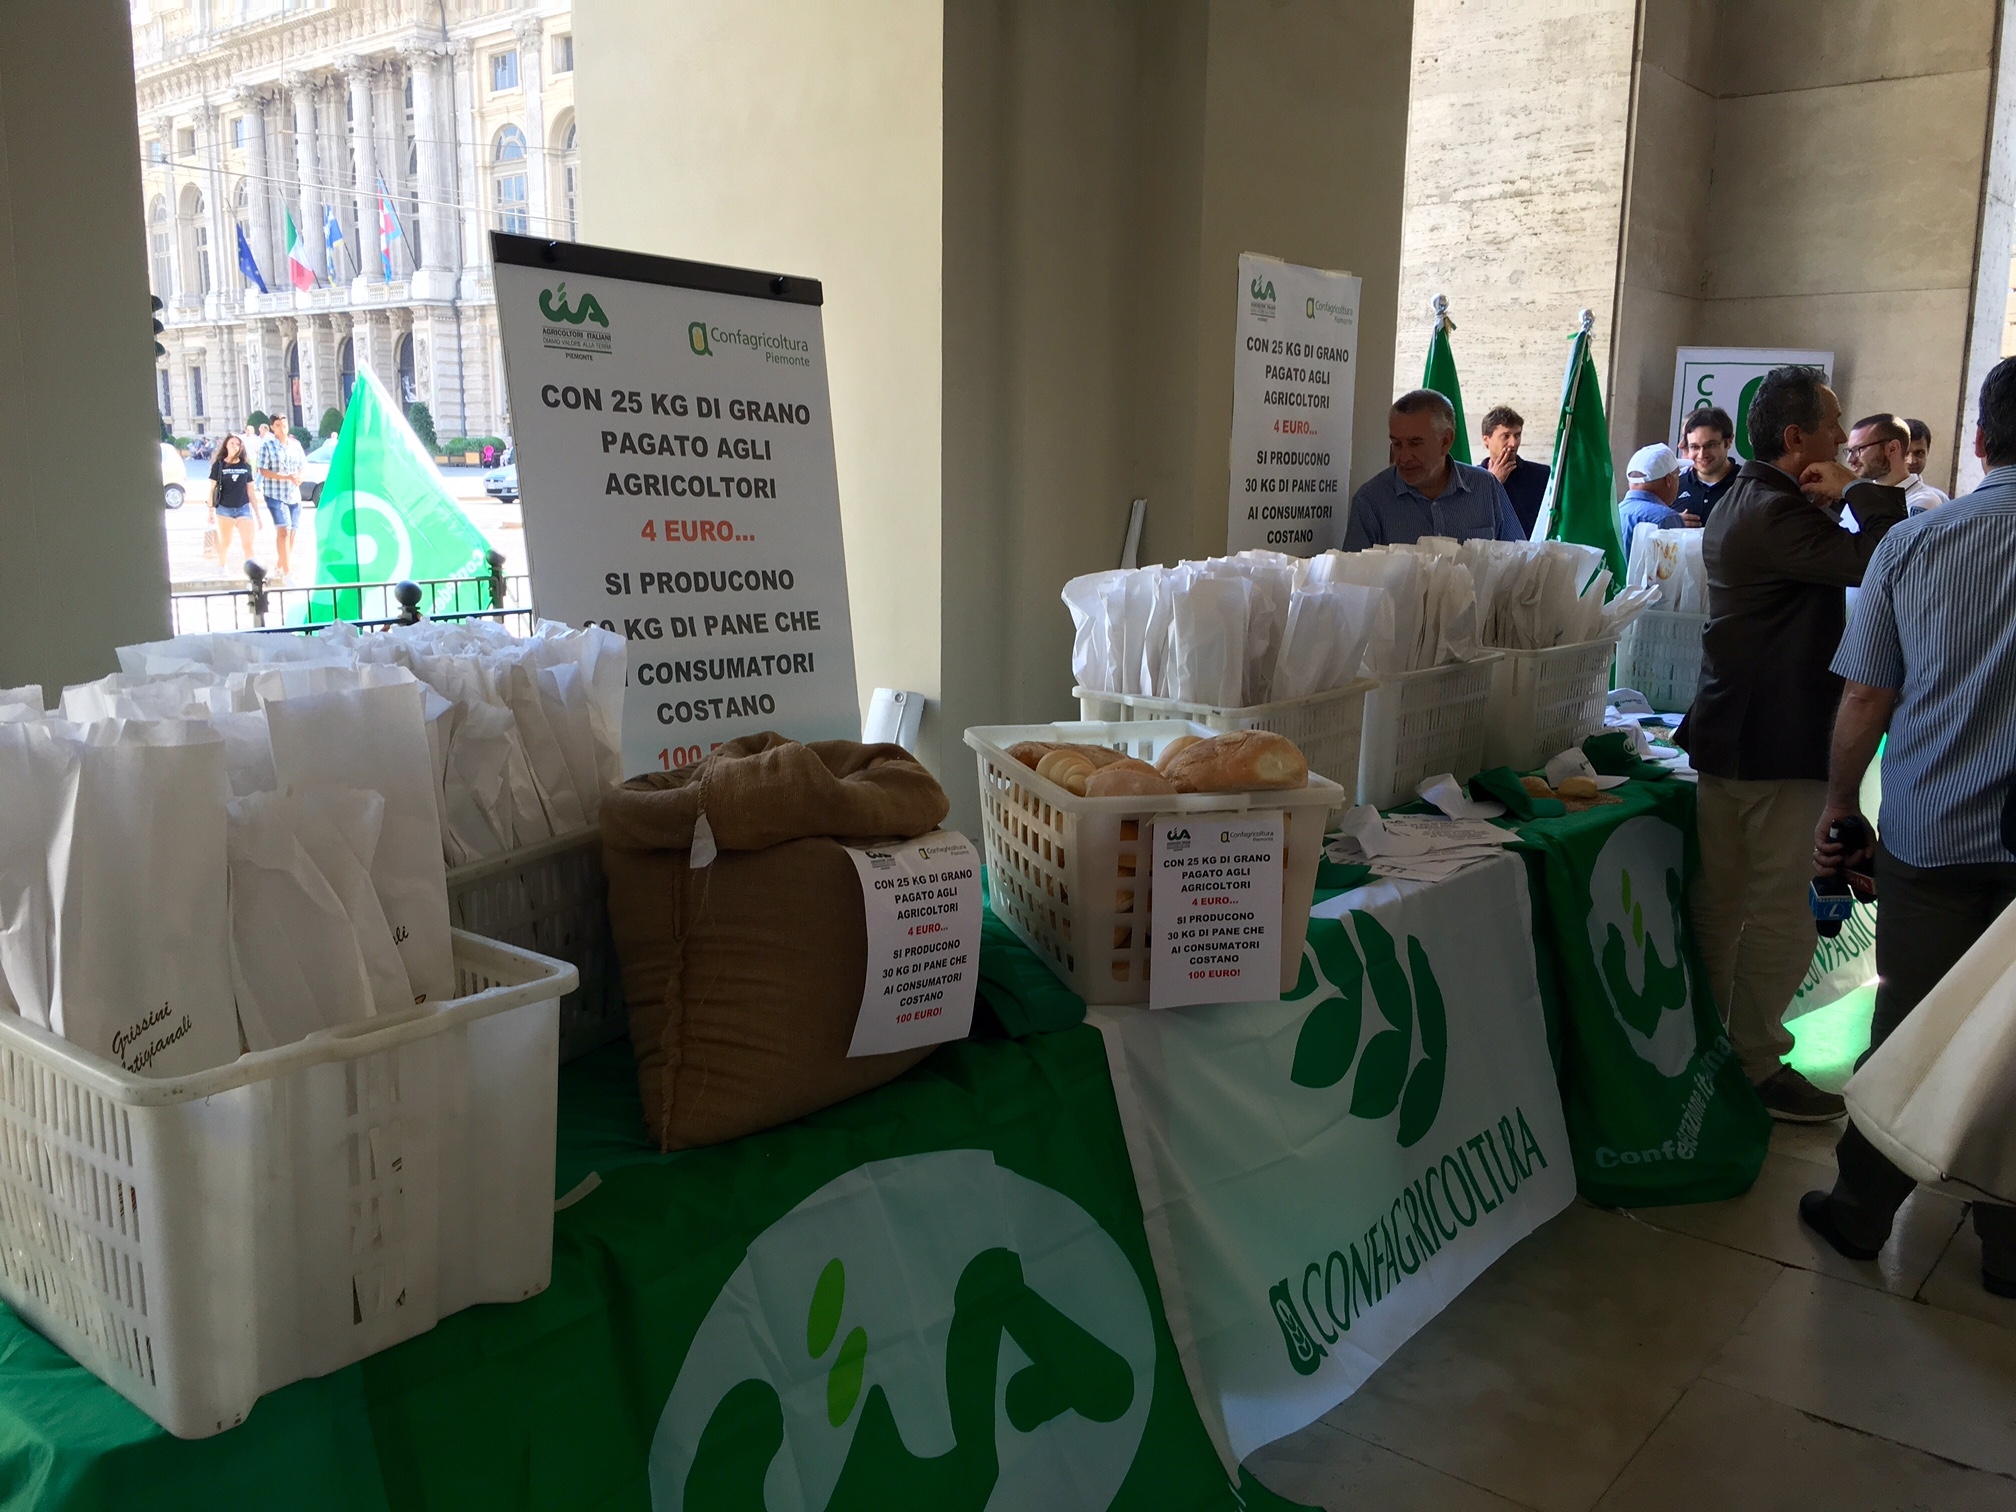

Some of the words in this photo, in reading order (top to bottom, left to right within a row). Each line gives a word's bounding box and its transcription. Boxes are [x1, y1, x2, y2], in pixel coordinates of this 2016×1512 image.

[1315, 300, 1353, 316] Confagricoltura
[542, 328, 584, 338] AGRICOLTORI
[586, 332, 612, 342] ITALIANI
[710, 327, 808, 352] Confagricoltura
[566, 352, 594, 361] PIEMONTE
[1247, 336, 1269, 353] CON
[1272, 340, 1283, 354] 25
[1286, 342, 1301, 357] KG
[1304, 344, 1314, 358] DI
[1316, 346, 1349, 362] GRANO
[766, 352, 810, 367] Piemonte
[1266, 365, 1306, 382] PAGATO
[1308, 370, 1330, 385] AGLI
[541, 384, 602, 411] CON
[611, 390, 643, 414] 25
[651, 393, 688, 418] KG
[698, 397, 721, 419] DI
[729, 400, 810, 425] GRANO
[1264, 390, 1330, 409] AGRICOLTORI
[1274, 419, 1280, 433] 4
[1282, 420, 1317, 435] EURO...
[601, 431, 708, 458] PAGATO
[718, 438, 772, 460] AGLI
[1257, 451, 1267, 464] SI
[1270, 451, 1330, 466] PRODUCONO
[605, 473, 776, 498] AGRICOLTORI
[1245, 478, 1257, 492] 30
[1260, 479, 1275, 492] KG
[1279, 479, 1288, 492] DI
[1292, 479, 1316, 492] PANE
[1319, 480, 1338, 492] CHE
[1248, 507, 1258, 520] AI
[1262, 506, 1332, 520] CONSUMATORI
[641, 520, 656, 542] 4
[665, 520, 756, 542] EURO...
[1267, 530, 1313, 544] COSTANO
[605, 573, 630, 595] SI
[641, 570, 794, 594] PRODUCONO
[624, 618, 663, 641] KG
[672, 616, 697, 638] DI
[704, 613, 768, 636] PANE
[776, 610, 821, 632] CHE
[638, 653, 814, 686] CONSUMATORI
[657, 694, 775, 724] COSTANO
[658, 744, 702, 770] 100
[1164, 859, 1184, 868] CON
[1188, 858, 1199, 866] 25
[1202, 856, 1216, 865] KG
[1234, 854, 1270, 863] GRANO
[874, 879, 894, 890] CON
[897, 877, 910, 887] 25
[912, 876, 926, 885] KG
[929, 874, 938, 883] DI
[942, 869, 972, 882] GRANO
[1182, 869, 1223, 879] PAGATO
[1226, 868, 1250, 876] AGLI
[895, 890, 934, 904] PAGATO
[937, 887, 957, 898] AGLI
[1181, 881, 1251, 893] AGRICOLTORI
[1201, 897, 1238, 905] EURO...
[897, 902, 958, 920] AGRICOLTORI
[1177, 916, 1186, 924] SI
[1189, 912, 1254, 923] PRODUCONO
[908, 927, 914, 936] 4
[1168, 932, 1179, 940] 30
[1182, 930, 1196, 938] KG
[1212, 927, 1240, 936] PANE
[1243, 926, 1264, 934] CHE
[893, 949, 902, 959] SI
[905, 939, 960, 958] PRODUCONO
[1171, 946, 1181, 954] AI
[1184, 941, 1259, 952] CONSUMATORI
[883, 968, 893, 979] 30
[896, 966, 909, 976] KG
[912, 963, 922, 972] DI
[924, 959, 947, 970] PANE
[950, 955, 967, 966] CHE
[1190, 955, 1239, 965] COSTANO
[1188, 970, 1205, 979] 100
[1209, 969, 1240, 978] EURO!
[884, 986, 894, 995] AI
[896, 972, 962, 993] CONSUMATORI
[900, 991, 943, 1007] COSTANO
[896, 1013, 912, 1024] 100
[914, 1007, 942, 1020] EURO!
[112, 1001, 172, 1060] Grissini
[1302, 1106, 1548, 1344] CONFAGRICOLTURA
